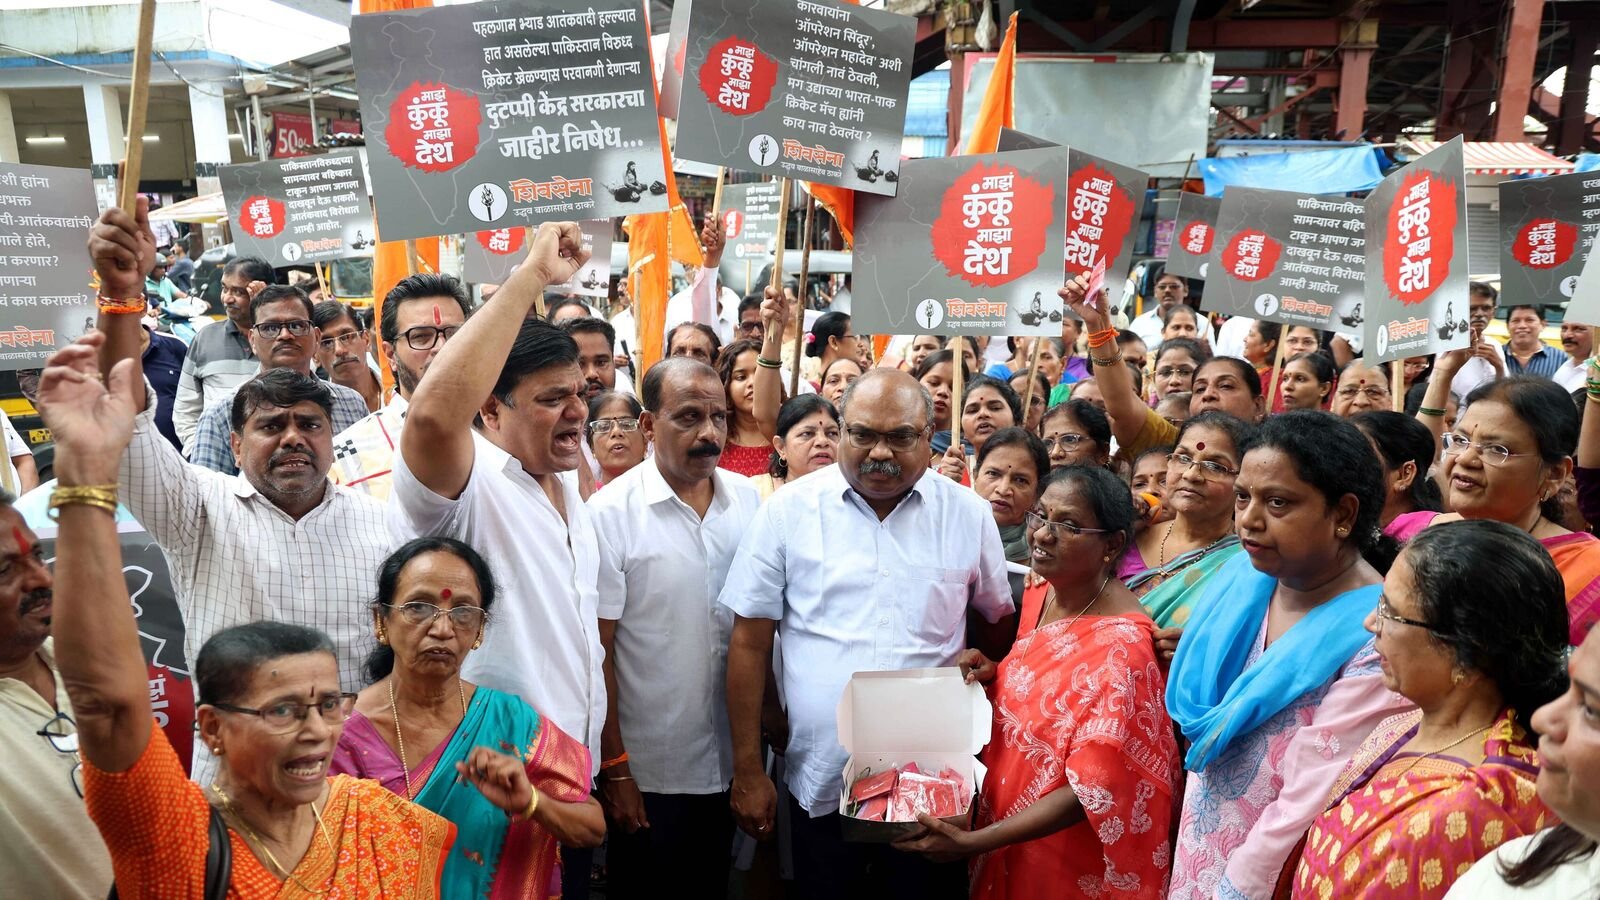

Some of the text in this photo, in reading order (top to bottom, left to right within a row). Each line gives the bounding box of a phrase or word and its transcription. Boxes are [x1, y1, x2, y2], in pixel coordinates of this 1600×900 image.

[796, 0, 851, 22] कारवायांना
[473, 7, 637, 38] पहलगाम भ्याड आतंकवादी हल्ल्यात
[483, 46, 502, 64] हात
[504, 39, 551, 60] असलेल्या
[551, 35, 601, 56] पाकिस्तान
[734, 45, 756, 59] माझं
[482, 67, 513, 90] क्रिकेट
[515, 66, 561, 86] खेळण्यास
[562, 59, 605, 81] परवानगी
[720, 48, 755, 80] कुंकू
[789, 57, 880, 89] चांगली नावं ठेवली,
[878, 57, 903, 72] अशी
[421, 87, 447, 102] माझं
[728, 77, 752, 91] माझा
[787, 77, 897, 109] मग उद्याच्या भारत-पाक
[718, 82, 751, 110] देश
[406, 97, 449, 130] कुंकू
[485, 89, 646, 129] दुटप्पी केंद्र सरकारचा
[785, 94, 865, 123] क्रिकेट मॅच ह्यांनी
[423, 127, 452, 140] माझा
[782, 115, 806, 130] काय
[807, 121, 828, 135] नाव
[829, 121, 863, 141] ठेवलंय
[414, 138, 454, 164] देश
[498, 125, 561, 160] जाहीर
[782, 138, 845, 169] शिवसेना
[0, 172, 50, 189] शी ह्यांना
[309, 183, 332, 194] आपण
[332, 180, 359, 191] जगाला
[509, 175, 593, 203] शिवसेना
[982, 172, 1014, 191] माझं
[1090, 177, 1114, 196] माझं
[1409, 176, 1431, 201] माझं
[534, 200, 574, 217] बाळासाहेब
[574, 197, 596, 211] ठाकरे
[963, 184, 1014, 229] कुंकू
[1071, 180, 1111, 227] कुंकू
[1296, 197, 1366, 215] पाकिस्तानविरु
[0, 211, 92, 229] ची-आतंकवाद्यांची
[1292, 214, 1341, 229] सामन्यावर
[1398, 196, 1431, 245] कुंकू
[24, 232, 51, 249] होते,
[977, 227, 1013, 245] माझा
[1077, 222, 1104, 241] माझा
[1289, 230, 1319, 245] टाकून
[1319, 233, 1350, 247] आपण
[1528, 226, 1557, 247] कुंकू
[963, 240, 1013, 276] देश
[1065, 230, 1100, 269] देश
[1286, 246, 1322, 262] दाखवून
[1322, 247, 1342, 262] देऊ
[1407, 236, 1432, 258] माझा
[1529, 249, 1557, 266] देश
[9, 255, 60, 267] करणार?
[1234, 260, 1260, 278] देश
[1282, 261, 1366, 282] आतंकवाद विरोधा
[1279, 276, 1341, 295] आम्ही आहोत.
[1398, 256, 1432, 294] देश
[10, 296, 38, 307] काय
[39, 293, 89, 307] करायचं?
[945, 297, 1008, 319] शिवसेना
[0, 325, 55, 349] वसेना
